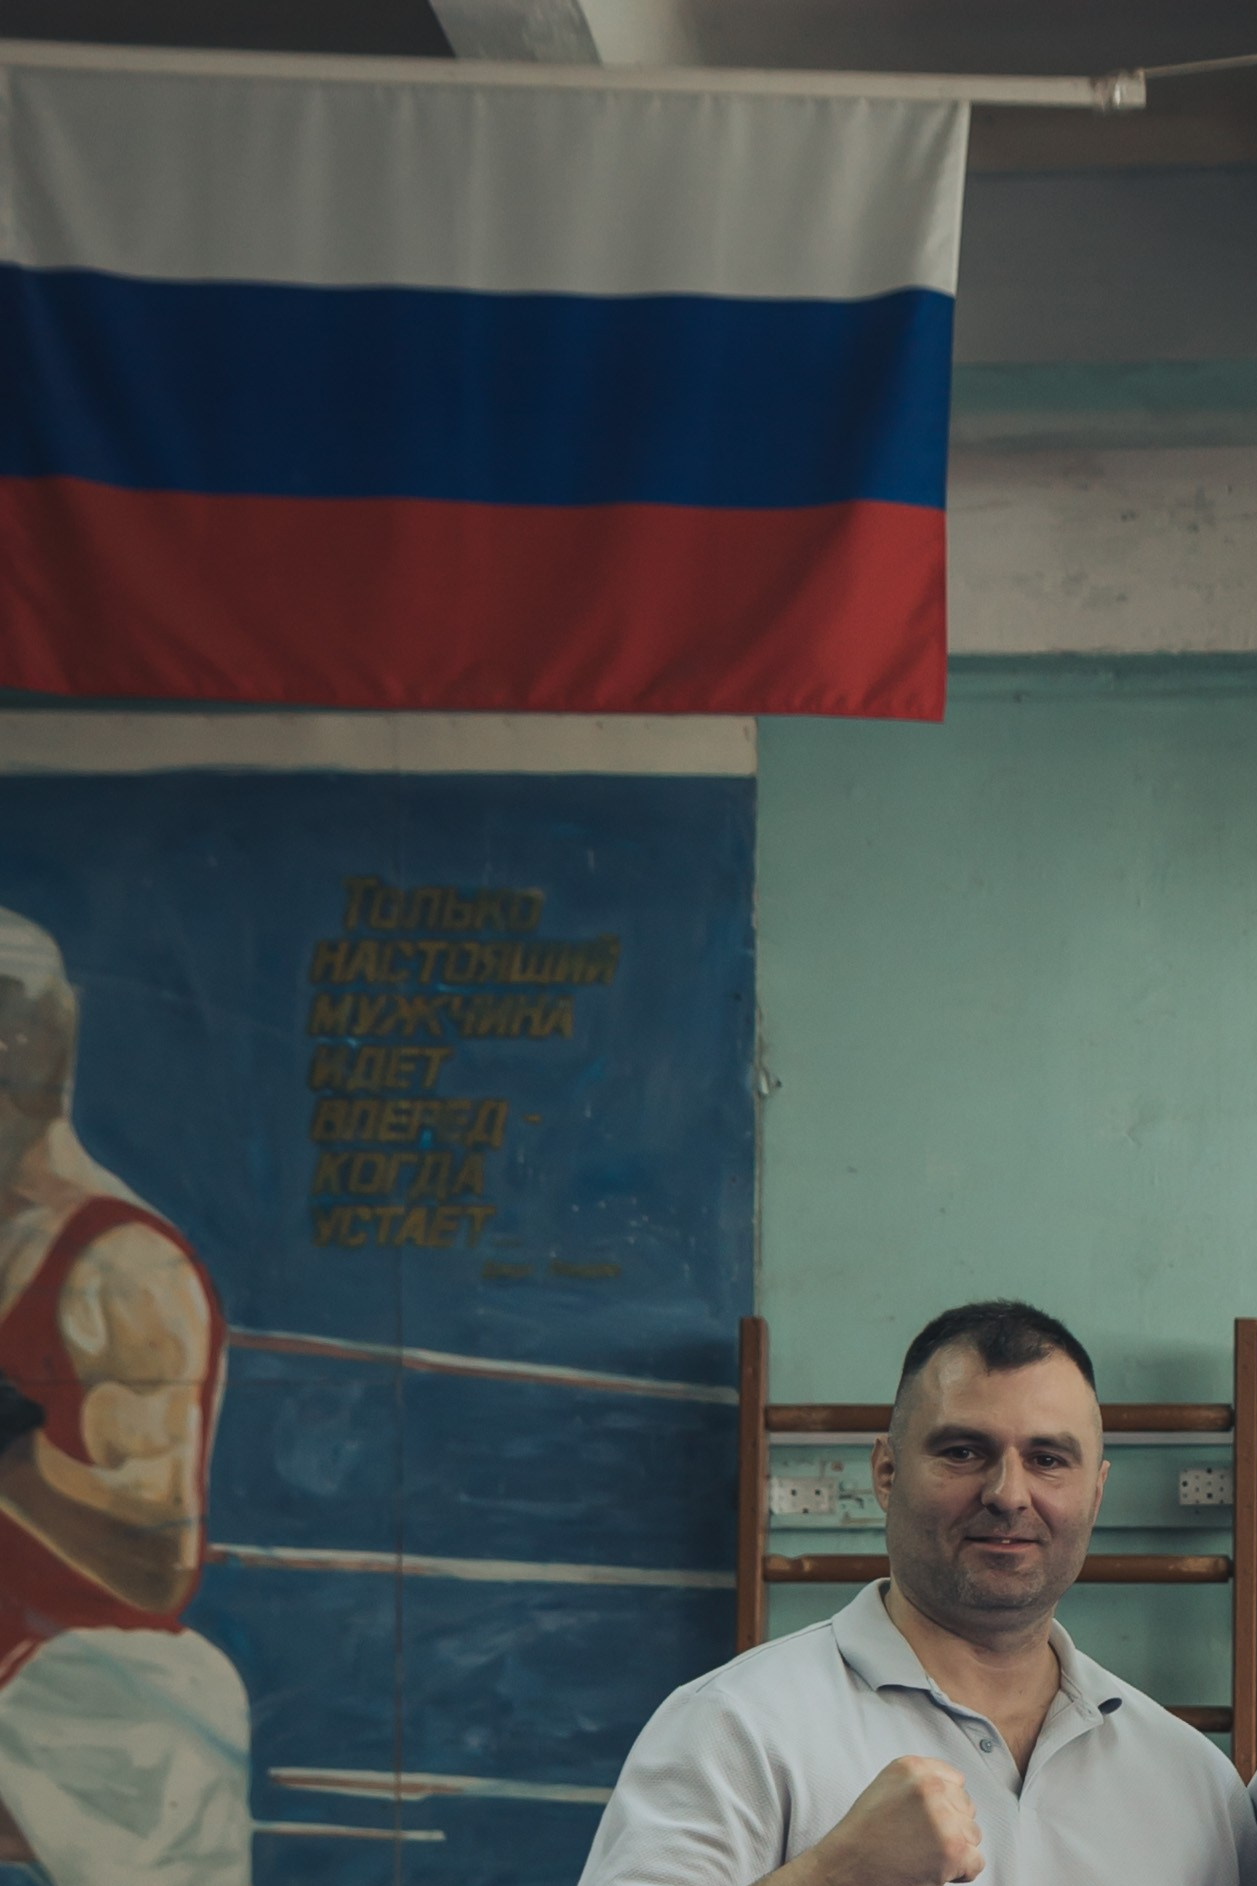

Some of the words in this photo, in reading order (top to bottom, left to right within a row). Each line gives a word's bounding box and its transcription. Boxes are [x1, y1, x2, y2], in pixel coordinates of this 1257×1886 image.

[306, 992, 574, 1040] МУЖЧИНА
[308, 1044, 453, 1092] ИДЕТ
[310, 1151, 485, 1199] КОГДА
